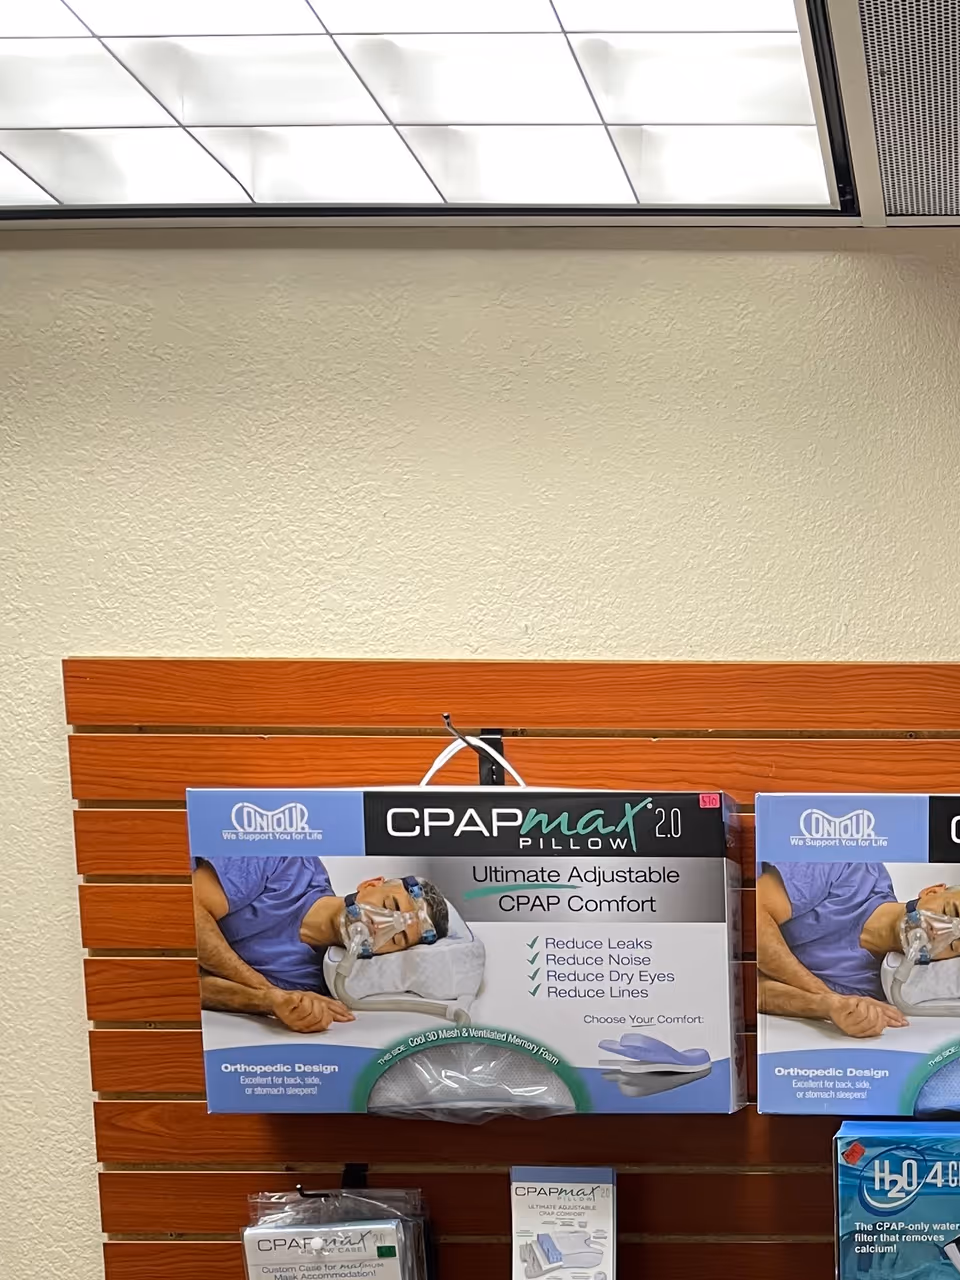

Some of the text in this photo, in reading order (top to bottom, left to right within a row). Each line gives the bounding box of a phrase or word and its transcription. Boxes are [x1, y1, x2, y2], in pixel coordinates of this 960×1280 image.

[231, 802, 308, 832] CONTOUR
[654, 807, 682, 838] 2.0
[799, 808, 875, 838] CONTOUR
[222, 832, 323, 842] We Support You for Life
[790, 838, 888, 847] We Support You for Life
[519, 837, 629, 850] PILLOW
[472, 865, 681, 887] Ultimate Adjustable
[498, 894, 658, 913] CPAP Comfort
[545, 937, 653, 950] Reduce Leaks
[545, 953, 651, 966] Reduce Noise
[546, 969, 675, 985] Reduce Dry Eyes
[547, 986, 649, 999] Reduce Lines
[583, 1014, 704, 1024] Choose Your Comfort:
[221, 1063, 338, 1074] Orthopedic Design
[774, 1067, 889, 1079] Orthopedic Design
[792, 1079, 872, 1089] Excellent for back, side,
[796, 1090, 868, 1100] or stomach sleepers!
[926, 1161, 944, 1188] 4
[854, 1222, 960, 1233] The CPAP-only water
[854, 1233, 945, 1243] filter that removes
[854, 1244, 897, 1254] calcium!
[261, 1264, 337, 1274] Custom Case for
[273, 1270, 377, 1280] Mask Accommodation!
